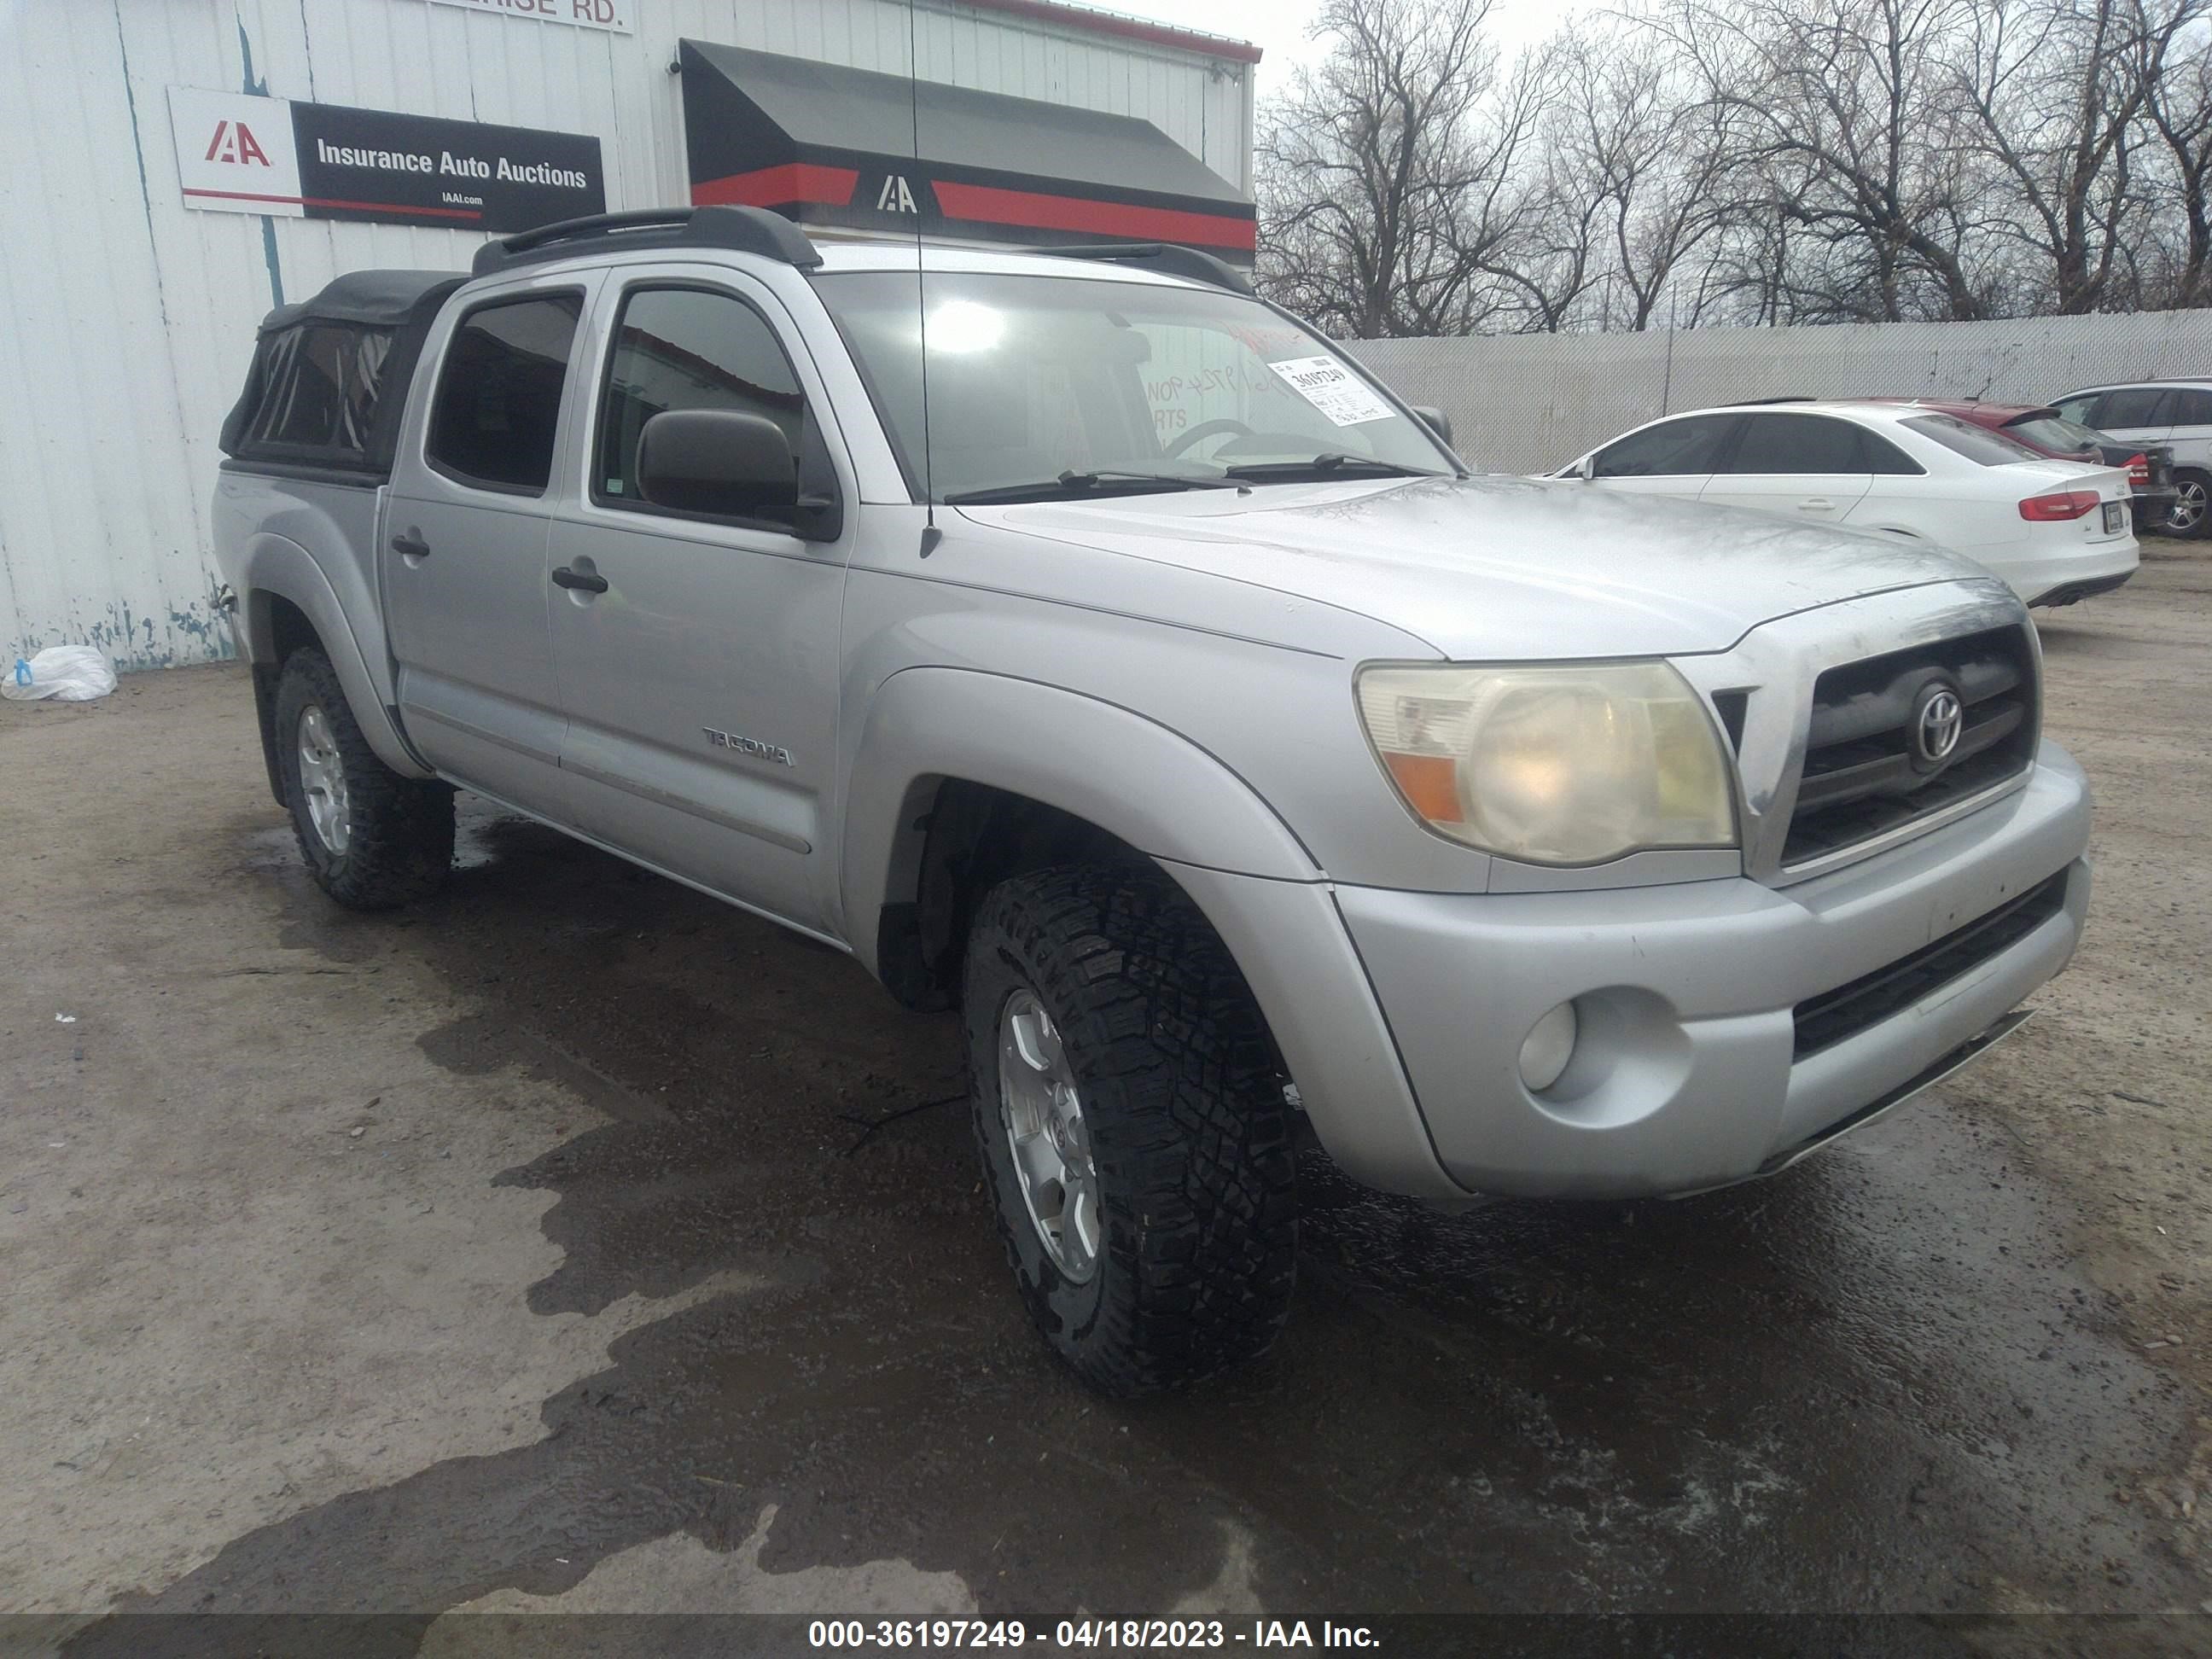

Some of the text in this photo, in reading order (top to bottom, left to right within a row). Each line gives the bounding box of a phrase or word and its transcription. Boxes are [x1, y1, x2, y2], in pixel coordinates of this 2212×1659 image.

[317, 138, 587, 189] Insurance Auto Auctions
[442, 192, 483, 206] IAAI.com
[1291, 369, 1346, 387] 36197249
[1154, 409, 1187, 430] RTS
[702, 726, 795, 767] TACOMA
